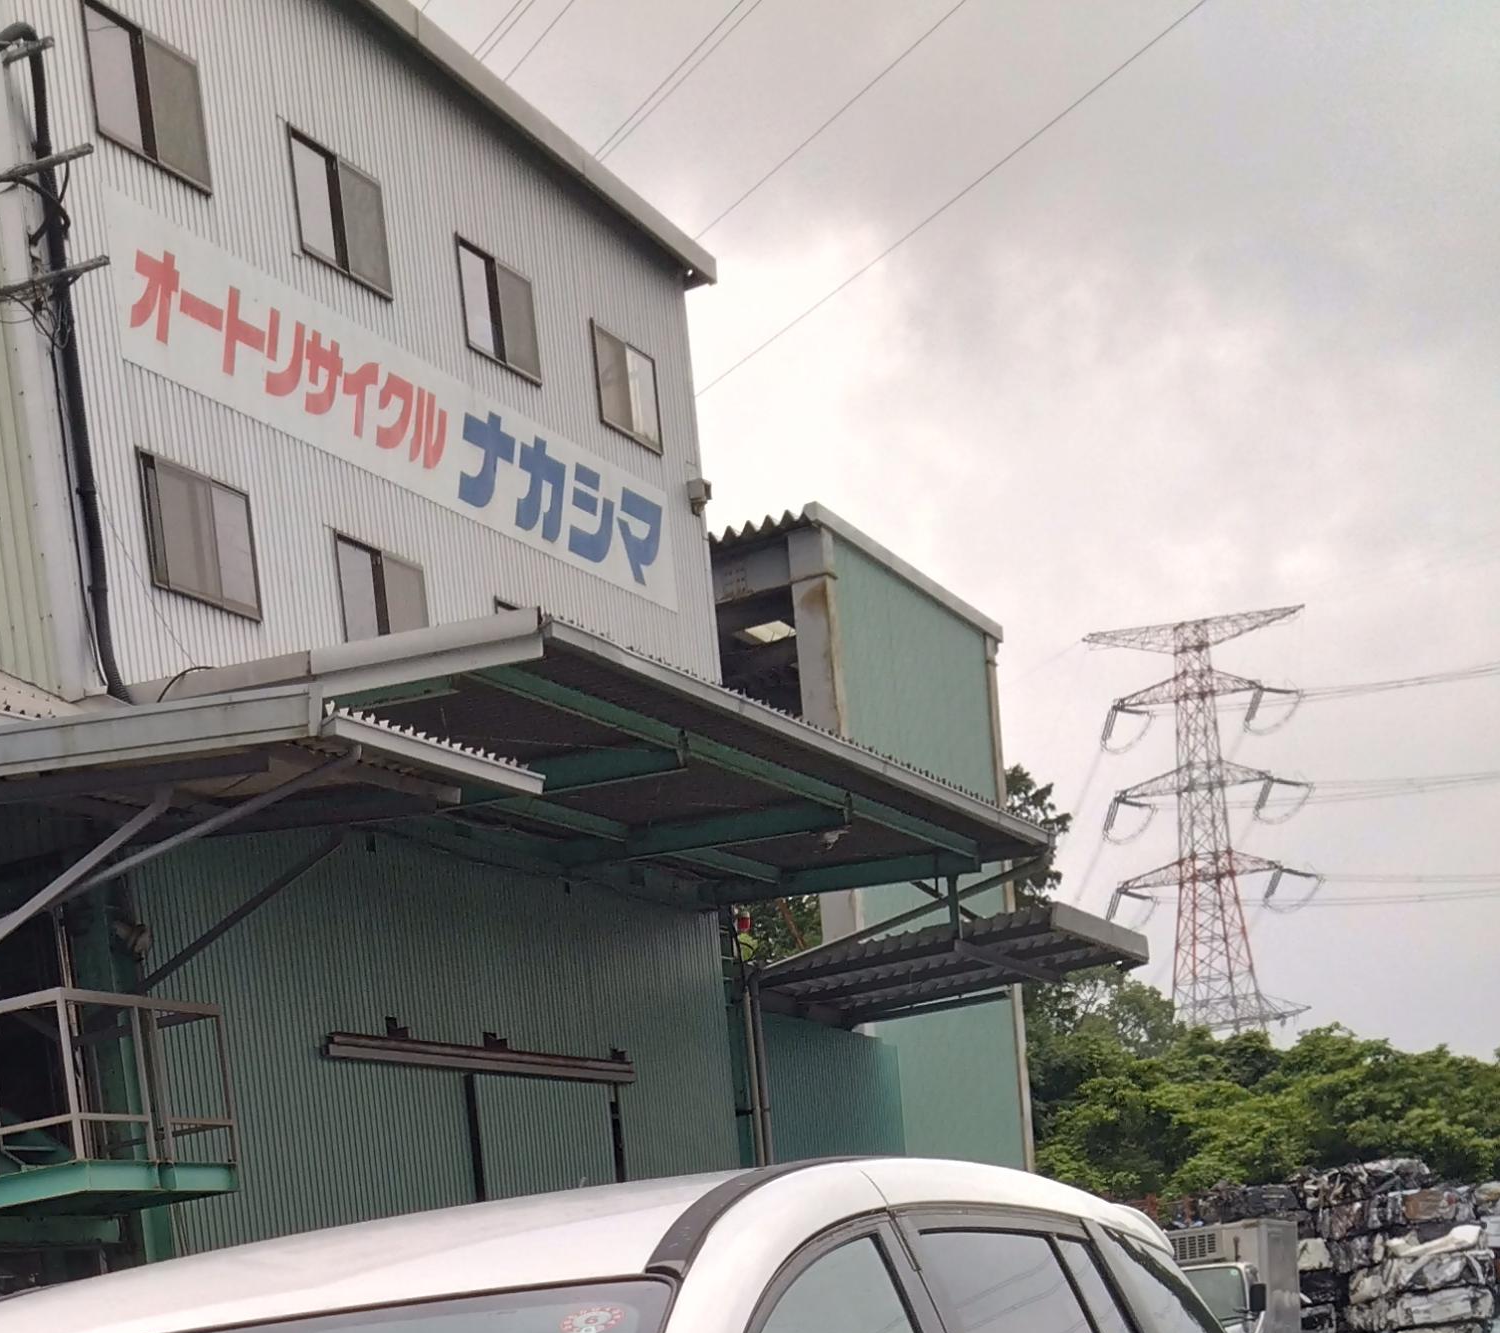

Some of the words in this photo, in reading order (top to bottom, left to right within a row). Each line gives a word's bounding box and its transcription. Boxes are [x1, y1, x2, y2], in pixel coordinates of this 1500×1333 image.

[130, 248, 448, 470] オートリサイクル
[457, 410, 664, 586] ナカシマ
